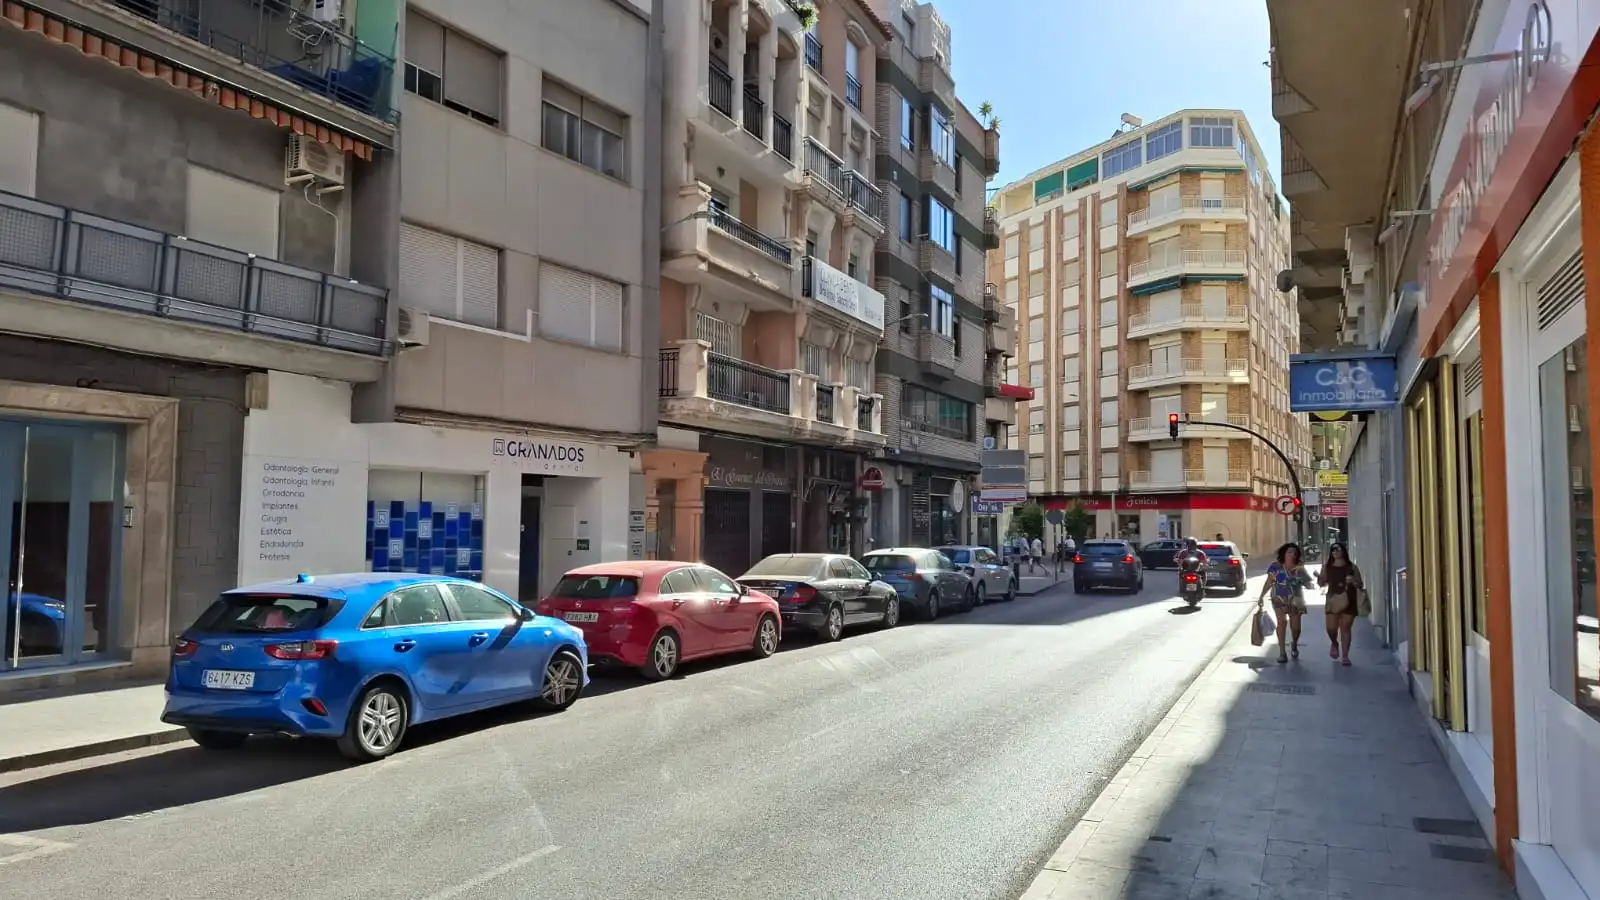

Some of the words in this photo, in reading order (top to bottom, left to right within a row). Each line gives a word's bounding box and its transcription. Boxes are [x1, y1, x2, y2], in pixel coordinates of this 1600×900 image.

[1315, 366, 1369, 387] C&C
[507, 441, 584, 463] GRANADOS
[312, 465, 339, 475] General
[262, 501, 298, 511] Implantes
[208, 671, 230, 684] 6417
[233, 672, 252, 685] KZS
